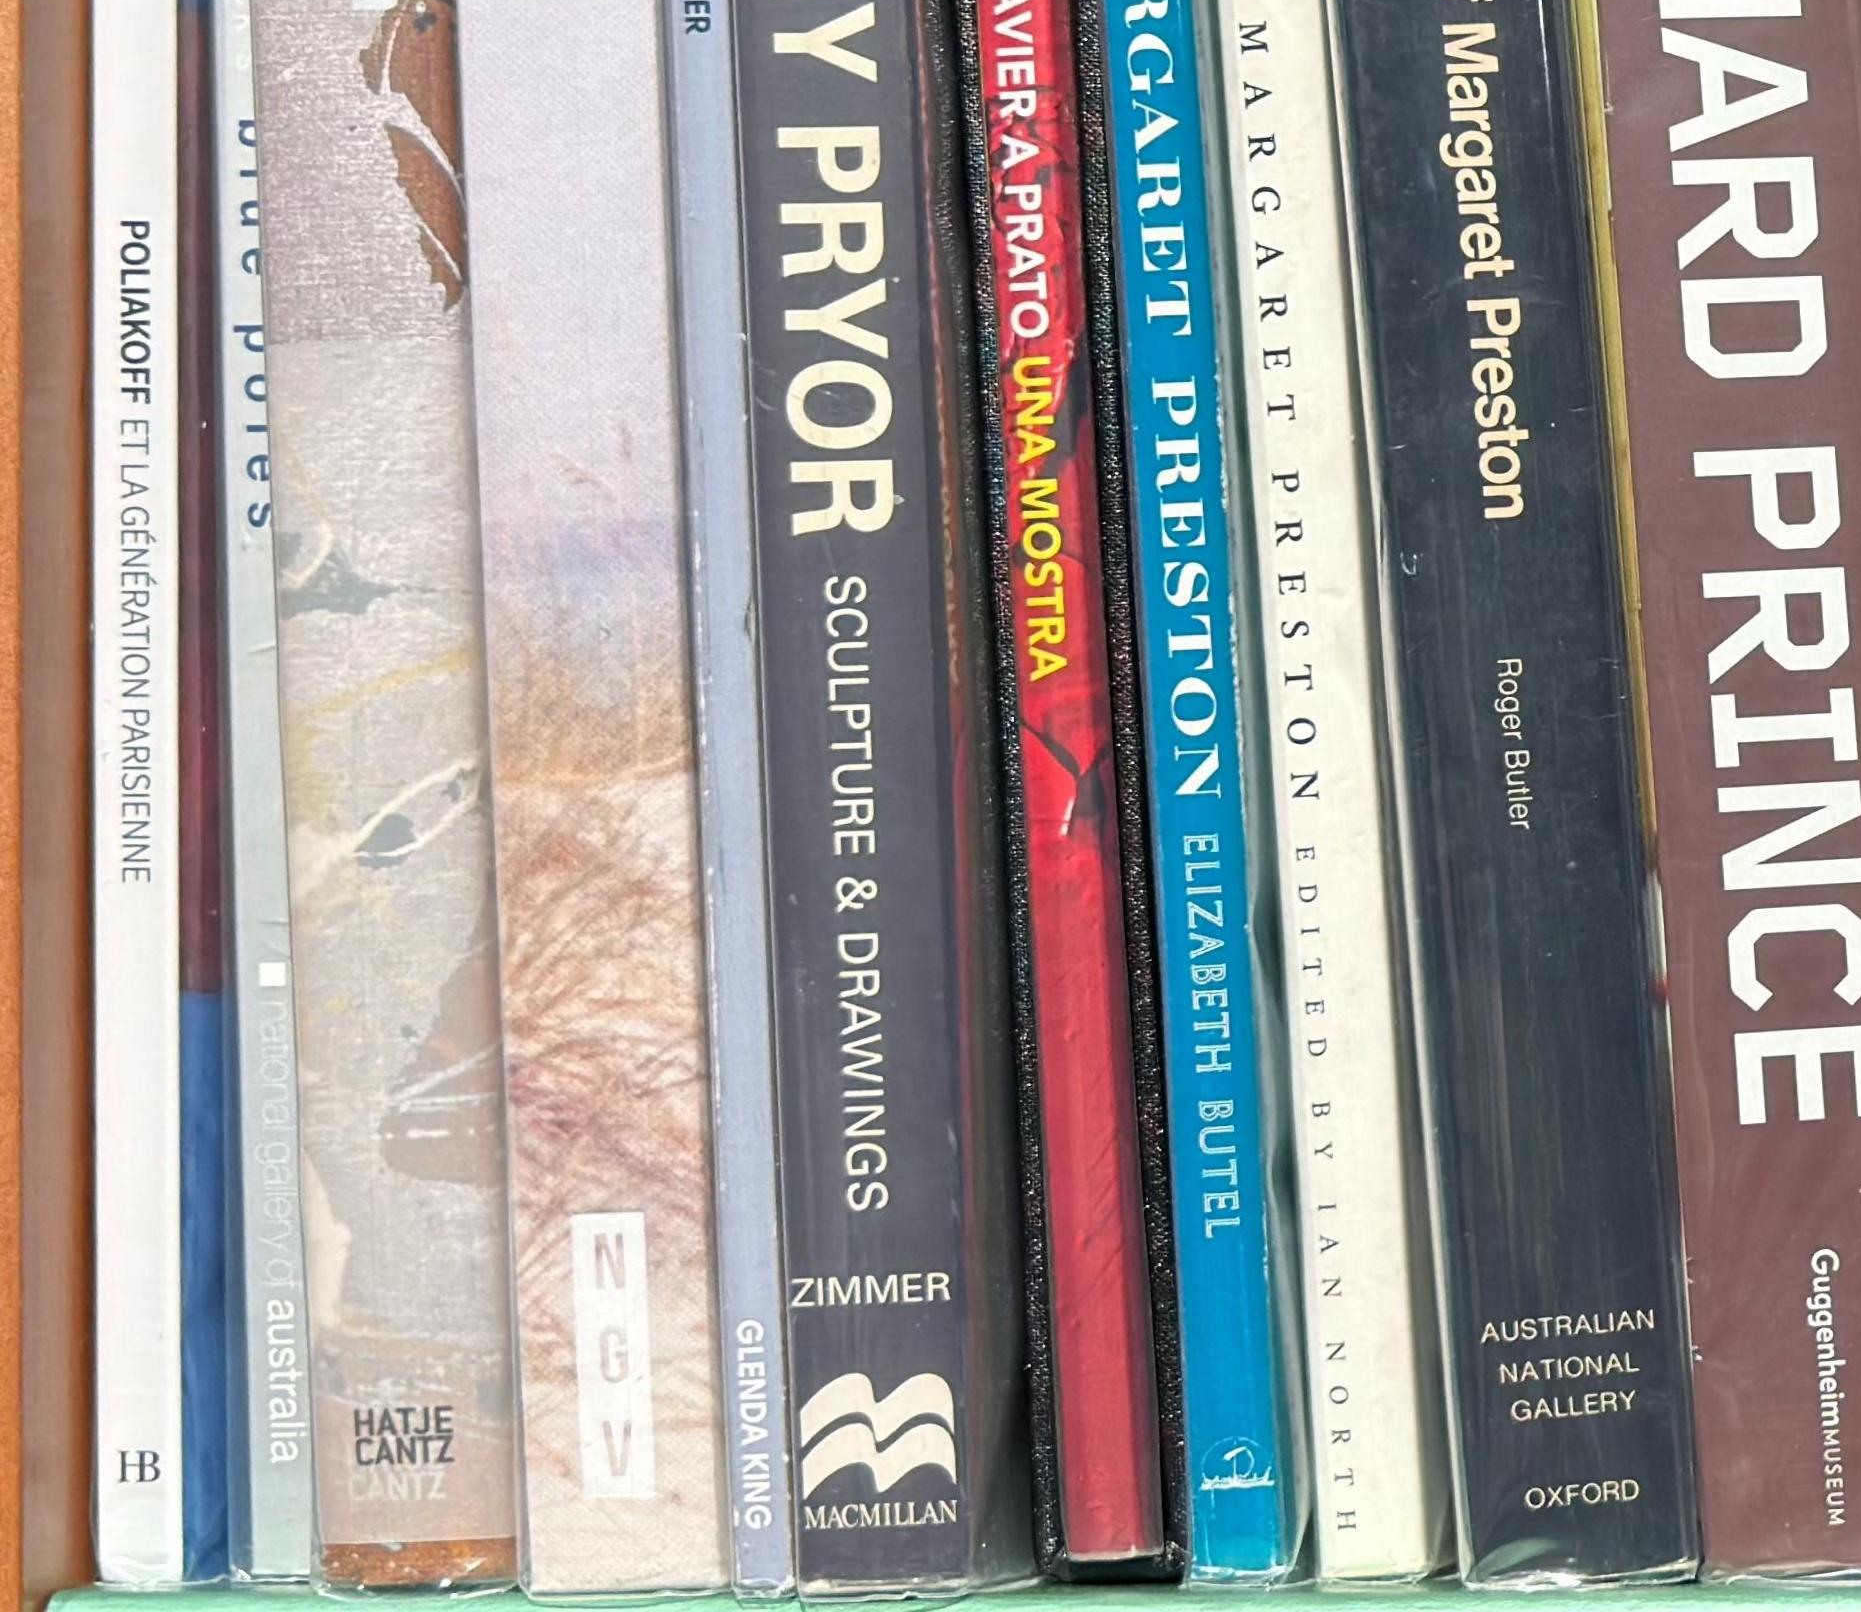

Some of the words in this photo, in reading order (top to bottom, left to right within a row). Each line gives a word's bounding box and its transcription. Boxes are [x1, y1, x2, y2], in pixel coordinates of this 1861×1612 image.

[1000, 134, 1039, 169] A
[1439, 21, 1515, 278] Margaret
[1003, 184, 1050, 338] PRATO
[1236, 19, 1296, 421] MARGARET
[118, 220, 150, 404] POLIAKOFF
[776, 124, 896, 536] PRYOR
[120, 420, 149, 455] ET
[1012, 355, 1055, 462] UNA
[1465, 297, 1530, 520] Preston
[120, 464, 149, 499] LA
[119, 506, 157, 697] GÉNÉRATION
[1020, 476, 1068, 681] MOSTRA
[1149, 376, 1223, 798] PRESTON
[1270, 469, 1320, 800] PRESTON
[823, 575, 876, 856] SCULPTURE
[1493, 656, 1528, 741] Roger
[119, 710, 151, 883] PARISIENNE
[1504, 748, 1533, 830] Butler
[836, 876, 879, 913] &
[1180, 832, 1233, 1074] ELIZABETH
[1295, 845, 1328, 1059] EDITED
[259, 998, 292, 1129] national
[838, 933, 889, 1211] DRAWINGS
[1198, 1098, 1241, 1239] BUTEL
[1310, 1101, 1333, 1160] BY
[257, 1142, 294, 1247] gallery
[1317, 1201, 1343, 1299] IAN
[791, 1271, 952, 1308] ZIMMER
[1480, 1308, 1656, 1344] AUSTRALIAN
[265, 1298, 300, 1463] australia
[353, 1406, 454, 1437] HATJE
[734, 1319, 768, 1446] GLENDA
[1499, 1351, 1640, 1384] NATIONAL
[1510, 1389, 1636, 1422] GALLERY
[355, 1434, 456, 1466] CANTZ
[739, 1454, 771, 1531] KING
[1323, 1339, 1358, 1532] NORTH
[1523, 1478, 1640, 1510] OXFORD
[804, 1499, 958, 1531] MACMILLAN
